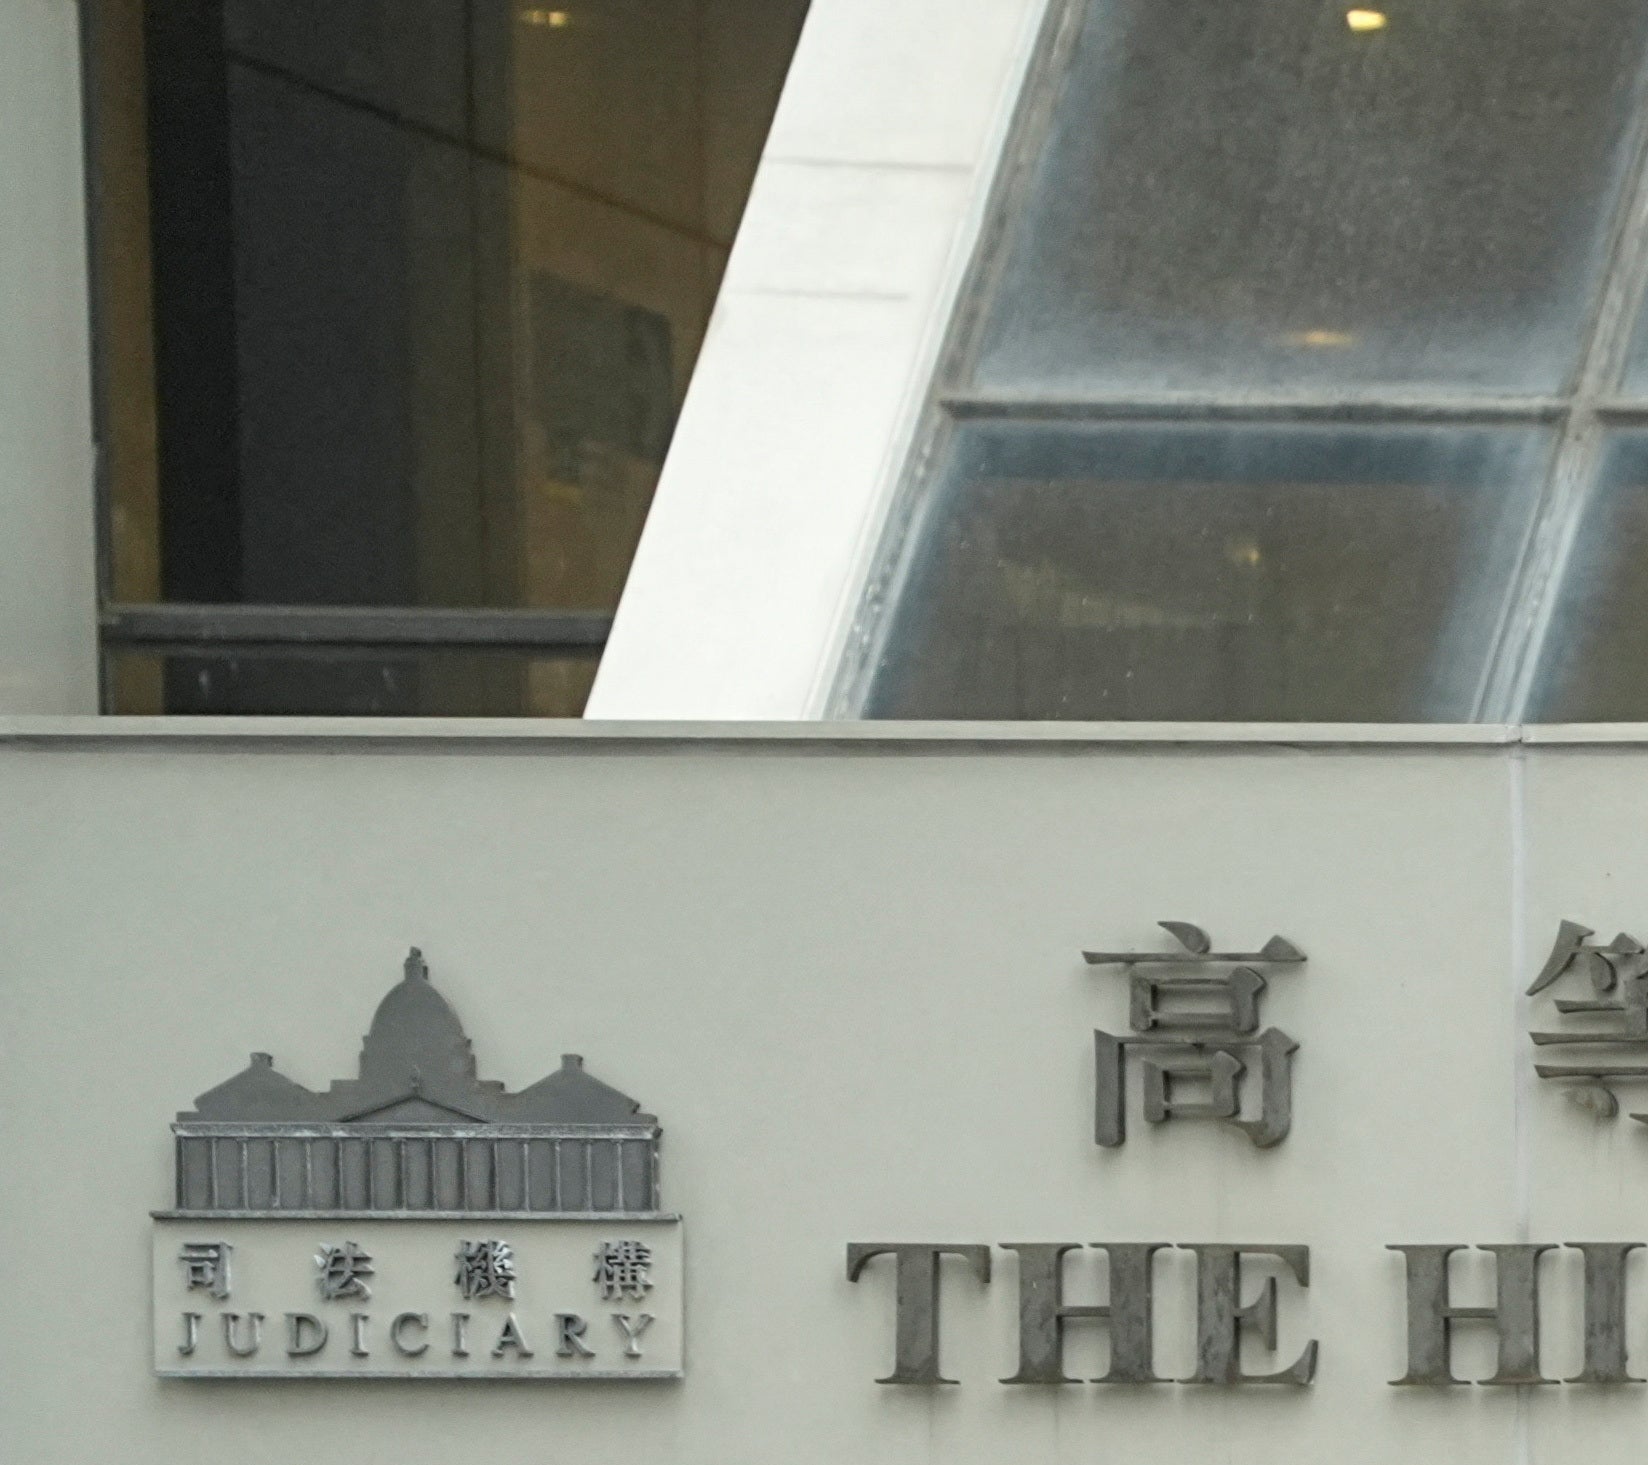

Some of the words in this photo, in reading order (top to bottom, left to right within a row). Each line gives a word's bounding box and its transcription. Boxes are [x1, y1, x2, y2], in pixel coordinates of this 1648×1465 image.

[178, 1240, 653, 1300] 司法機構
[178, 1312, 656, 1357] JUDICIARY
[847, 1240, 1318, 1388] THE
